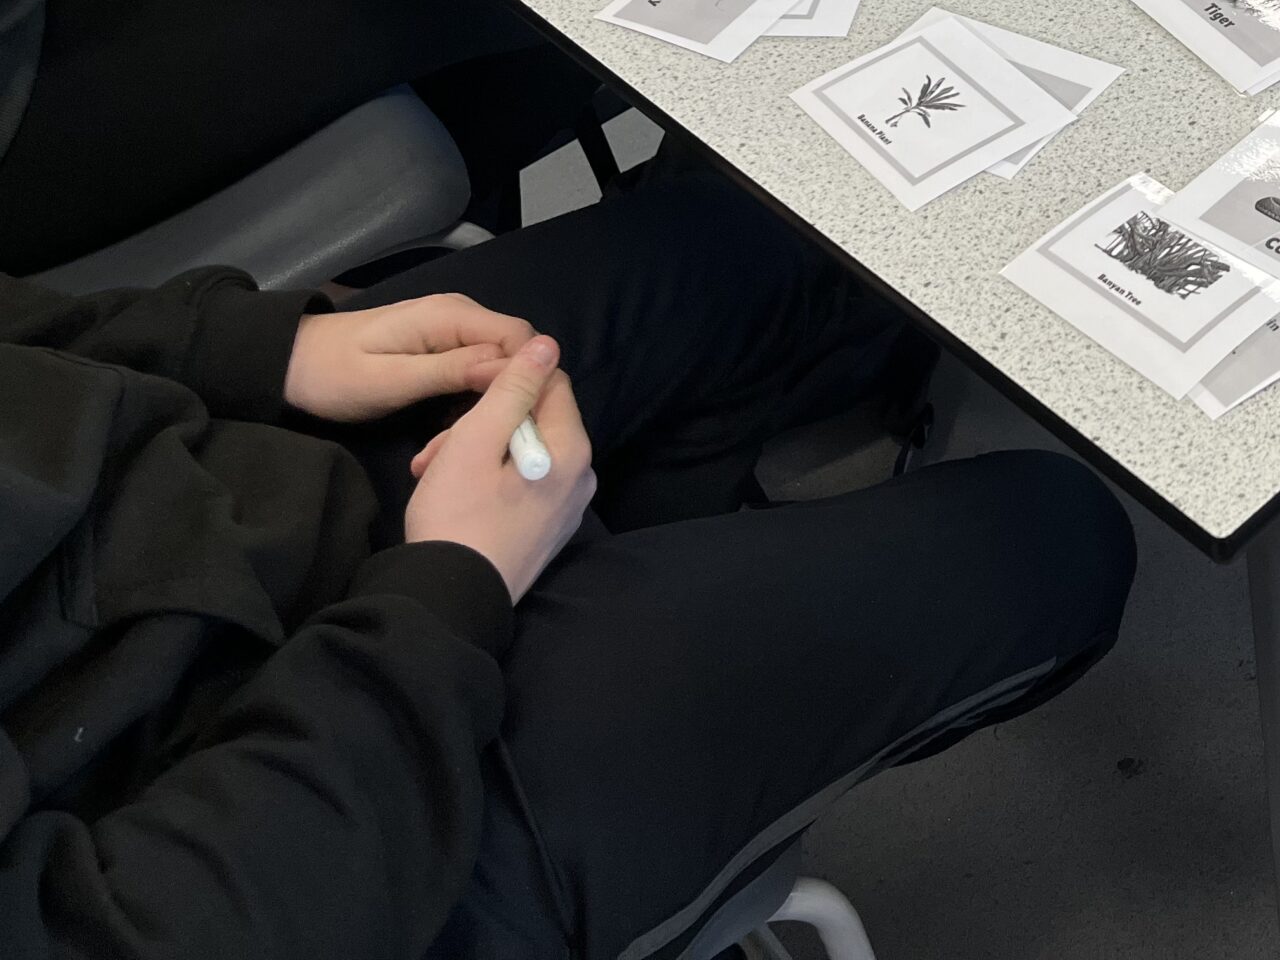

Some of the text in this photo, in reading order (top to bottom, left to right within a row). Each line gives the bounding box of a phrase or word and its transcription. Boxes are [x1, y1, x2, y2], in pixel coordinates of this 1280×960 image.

[1203, 2, 1236, 30] Tiger
[1098, 273, 1142, 306] Banyan Tree
